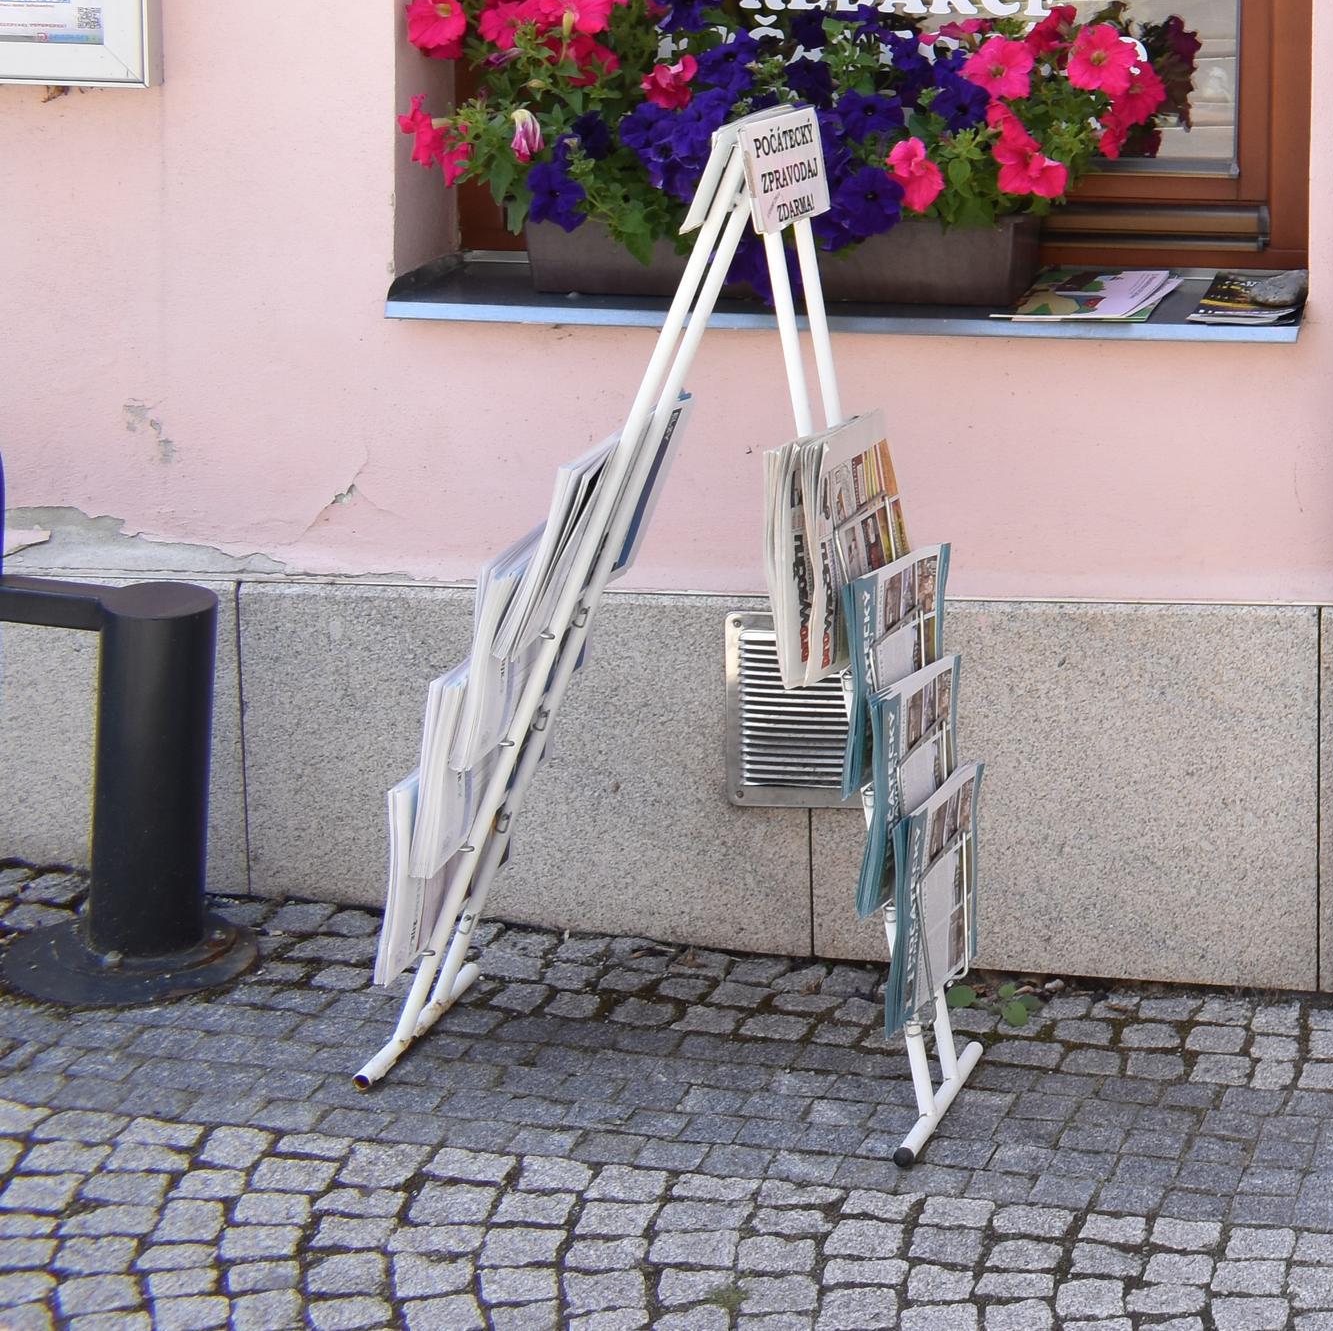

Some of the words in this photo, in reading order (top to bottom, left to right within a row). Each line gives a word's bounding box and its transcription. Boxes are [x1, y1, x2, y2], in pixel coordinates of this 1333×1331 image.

[753, 117, 814, 158] POČÁTECKÝ
[760, 156, 819, 194] ZPRAVODAJ
[776, 193, 815, 223] ZDARMA!
